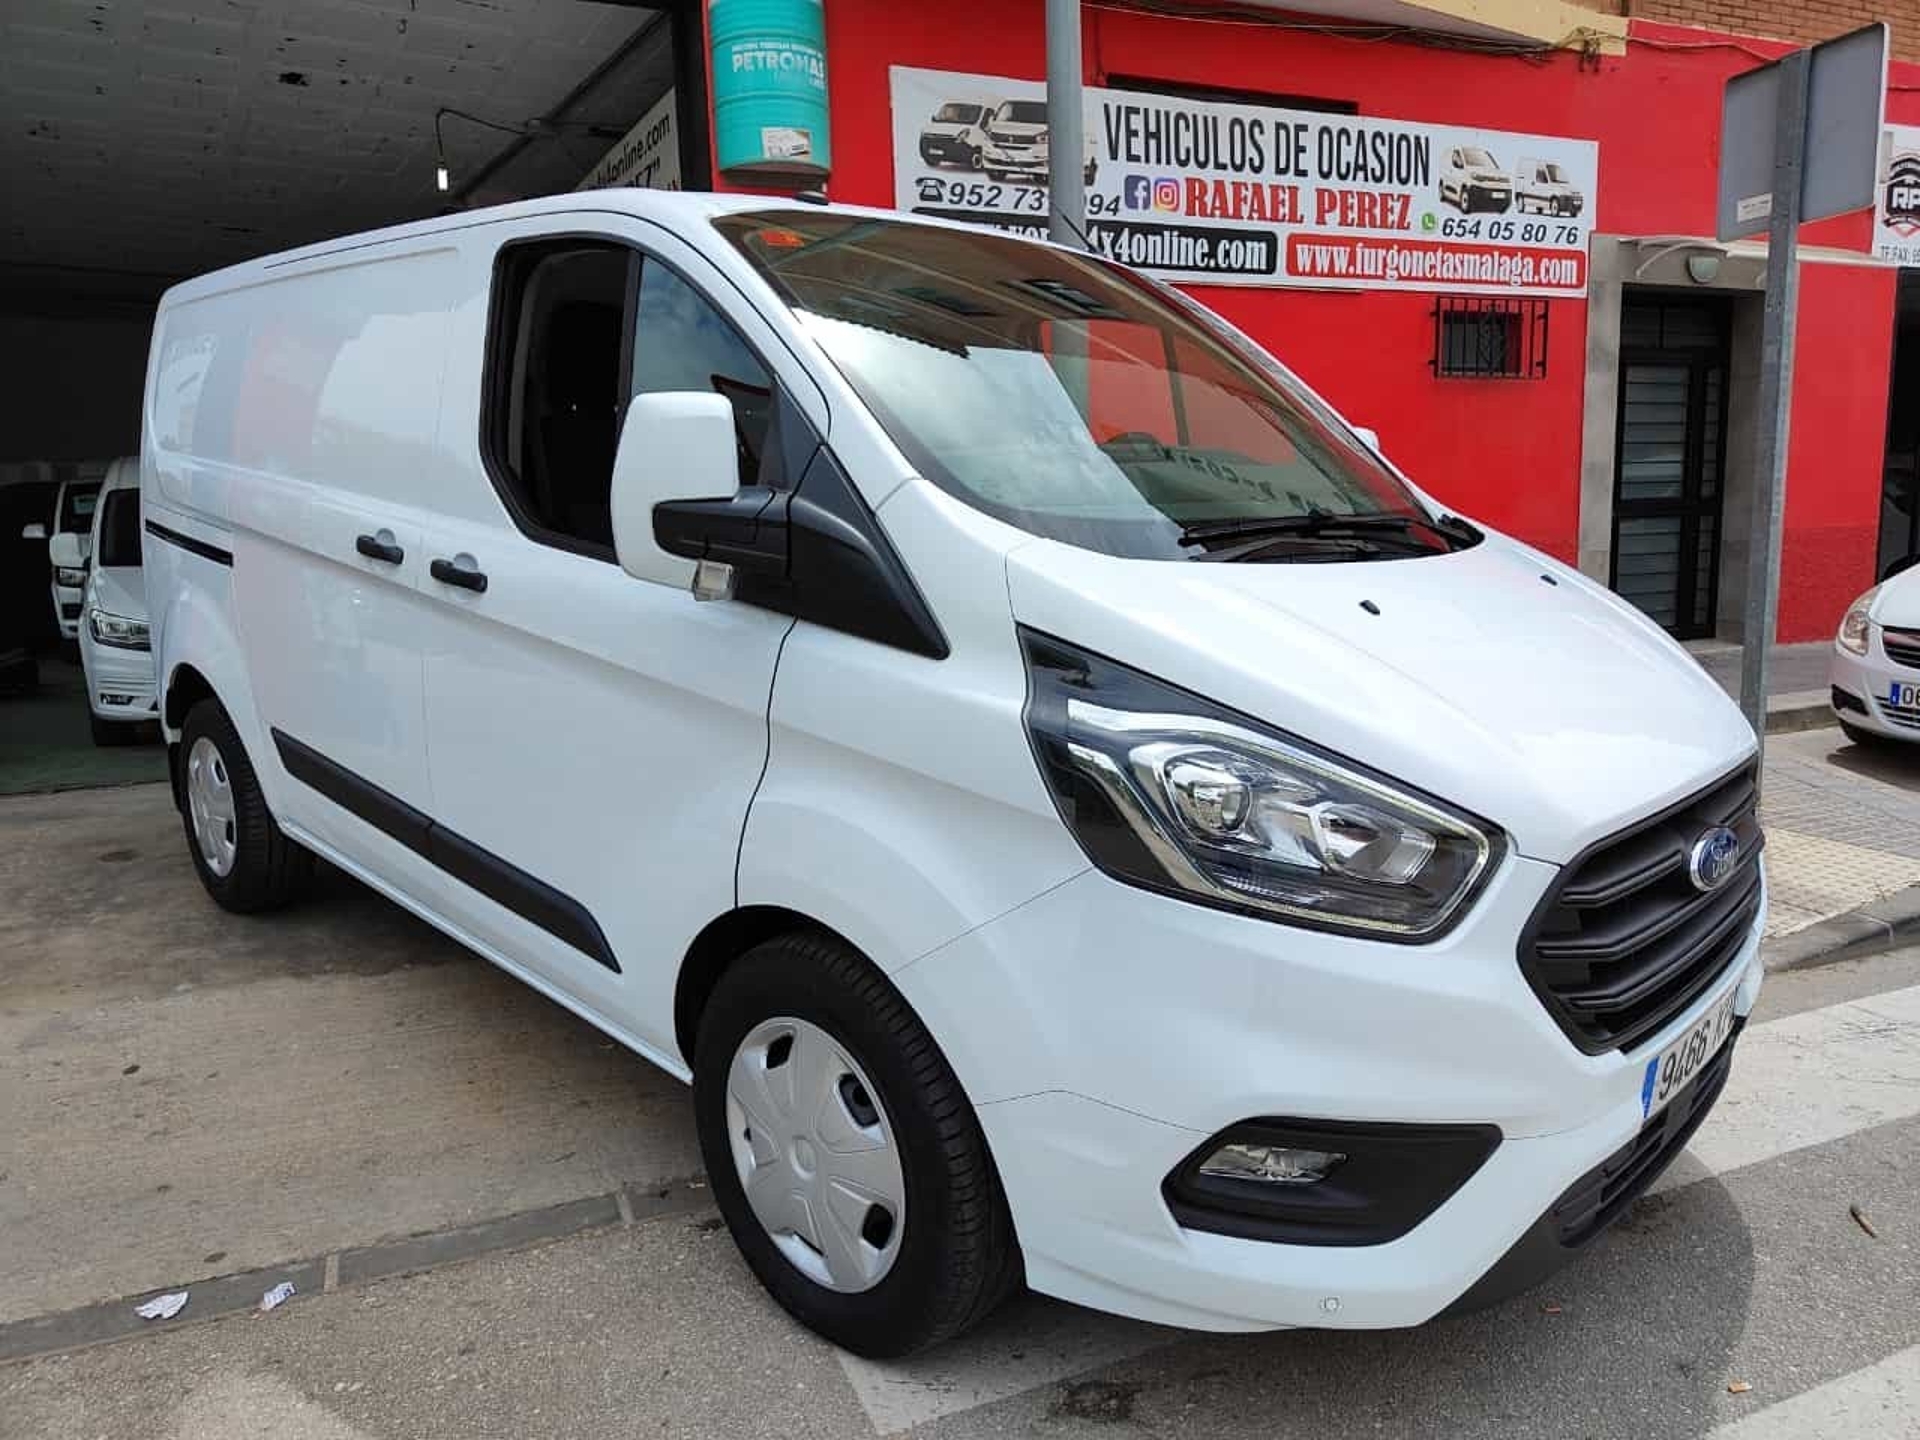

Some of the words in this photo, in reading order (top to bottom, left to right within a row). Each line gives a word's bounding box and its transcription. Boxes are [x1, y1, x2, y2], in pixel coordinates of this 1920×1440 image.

[1104, 103, 1265, 175] VEHICULOS
[1274, 121, 1309, 178] DE
[1317, 125, 1430, 187] OCASION
[949, 181, 1001, 208] 952
[1184, 176, 1305, 224] RAFAEL
[1315, 187, 1415, 230] PEREZ
[1442, 217, 1482, 239] 654
[1488, 221, 1515, 241] 05
[1521, 223, 1547, 243] 80
[1553, 225, 1579, 245] 76
[1296, 242, 1578, 286] www.furgonetasmalaga.com
